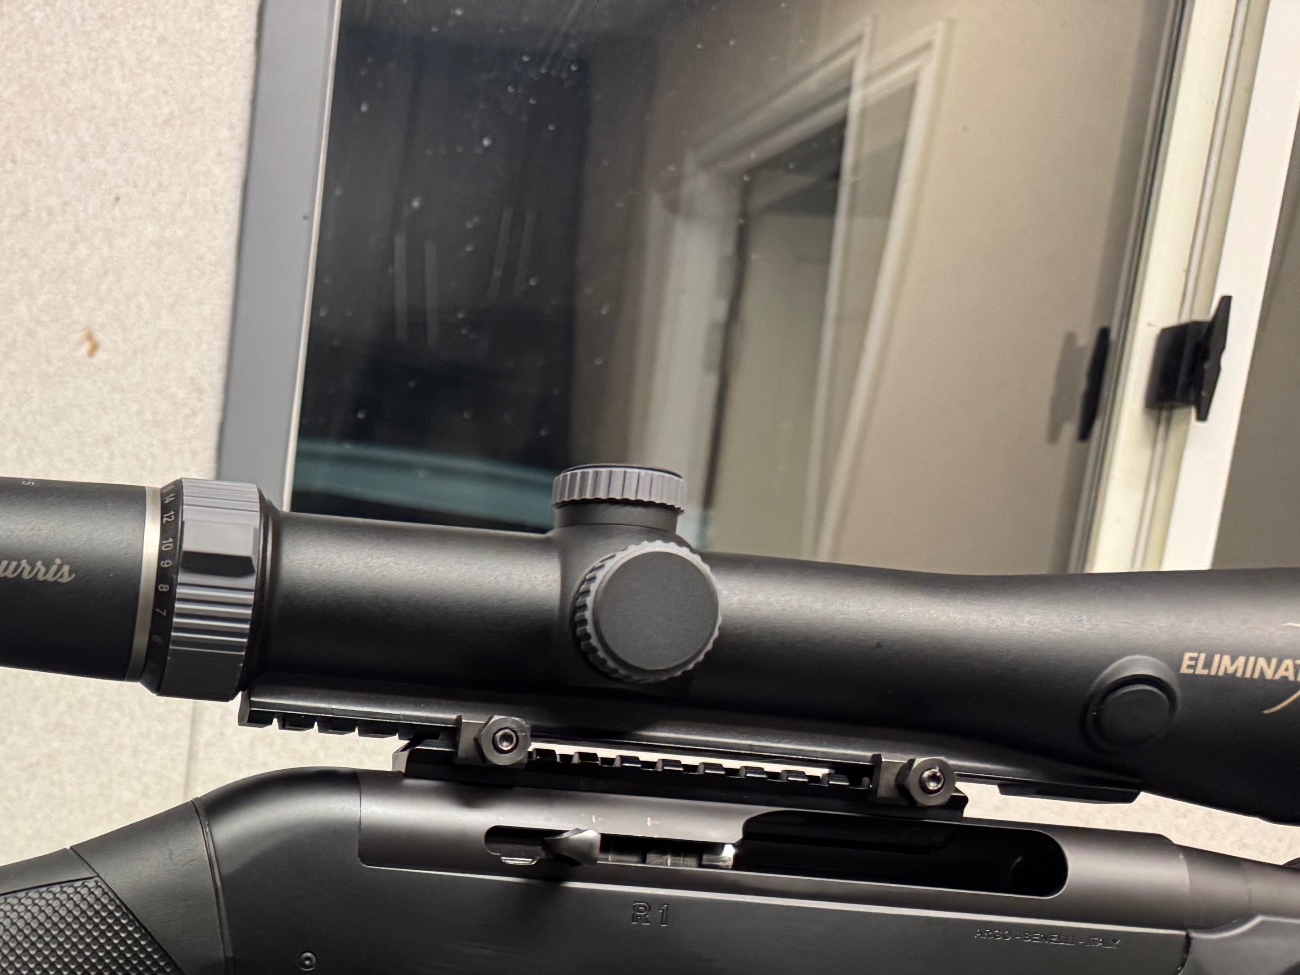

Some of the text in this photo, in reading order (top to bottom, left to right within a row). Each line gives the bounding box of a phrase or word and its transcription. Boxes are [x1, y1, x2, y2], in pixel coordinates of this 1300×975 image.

[162, 510, 175, 524] 12
[161, 537, 174, 551] 10
[160, 559, 172, 568] 9
[158, 584, 170, 592] 8
